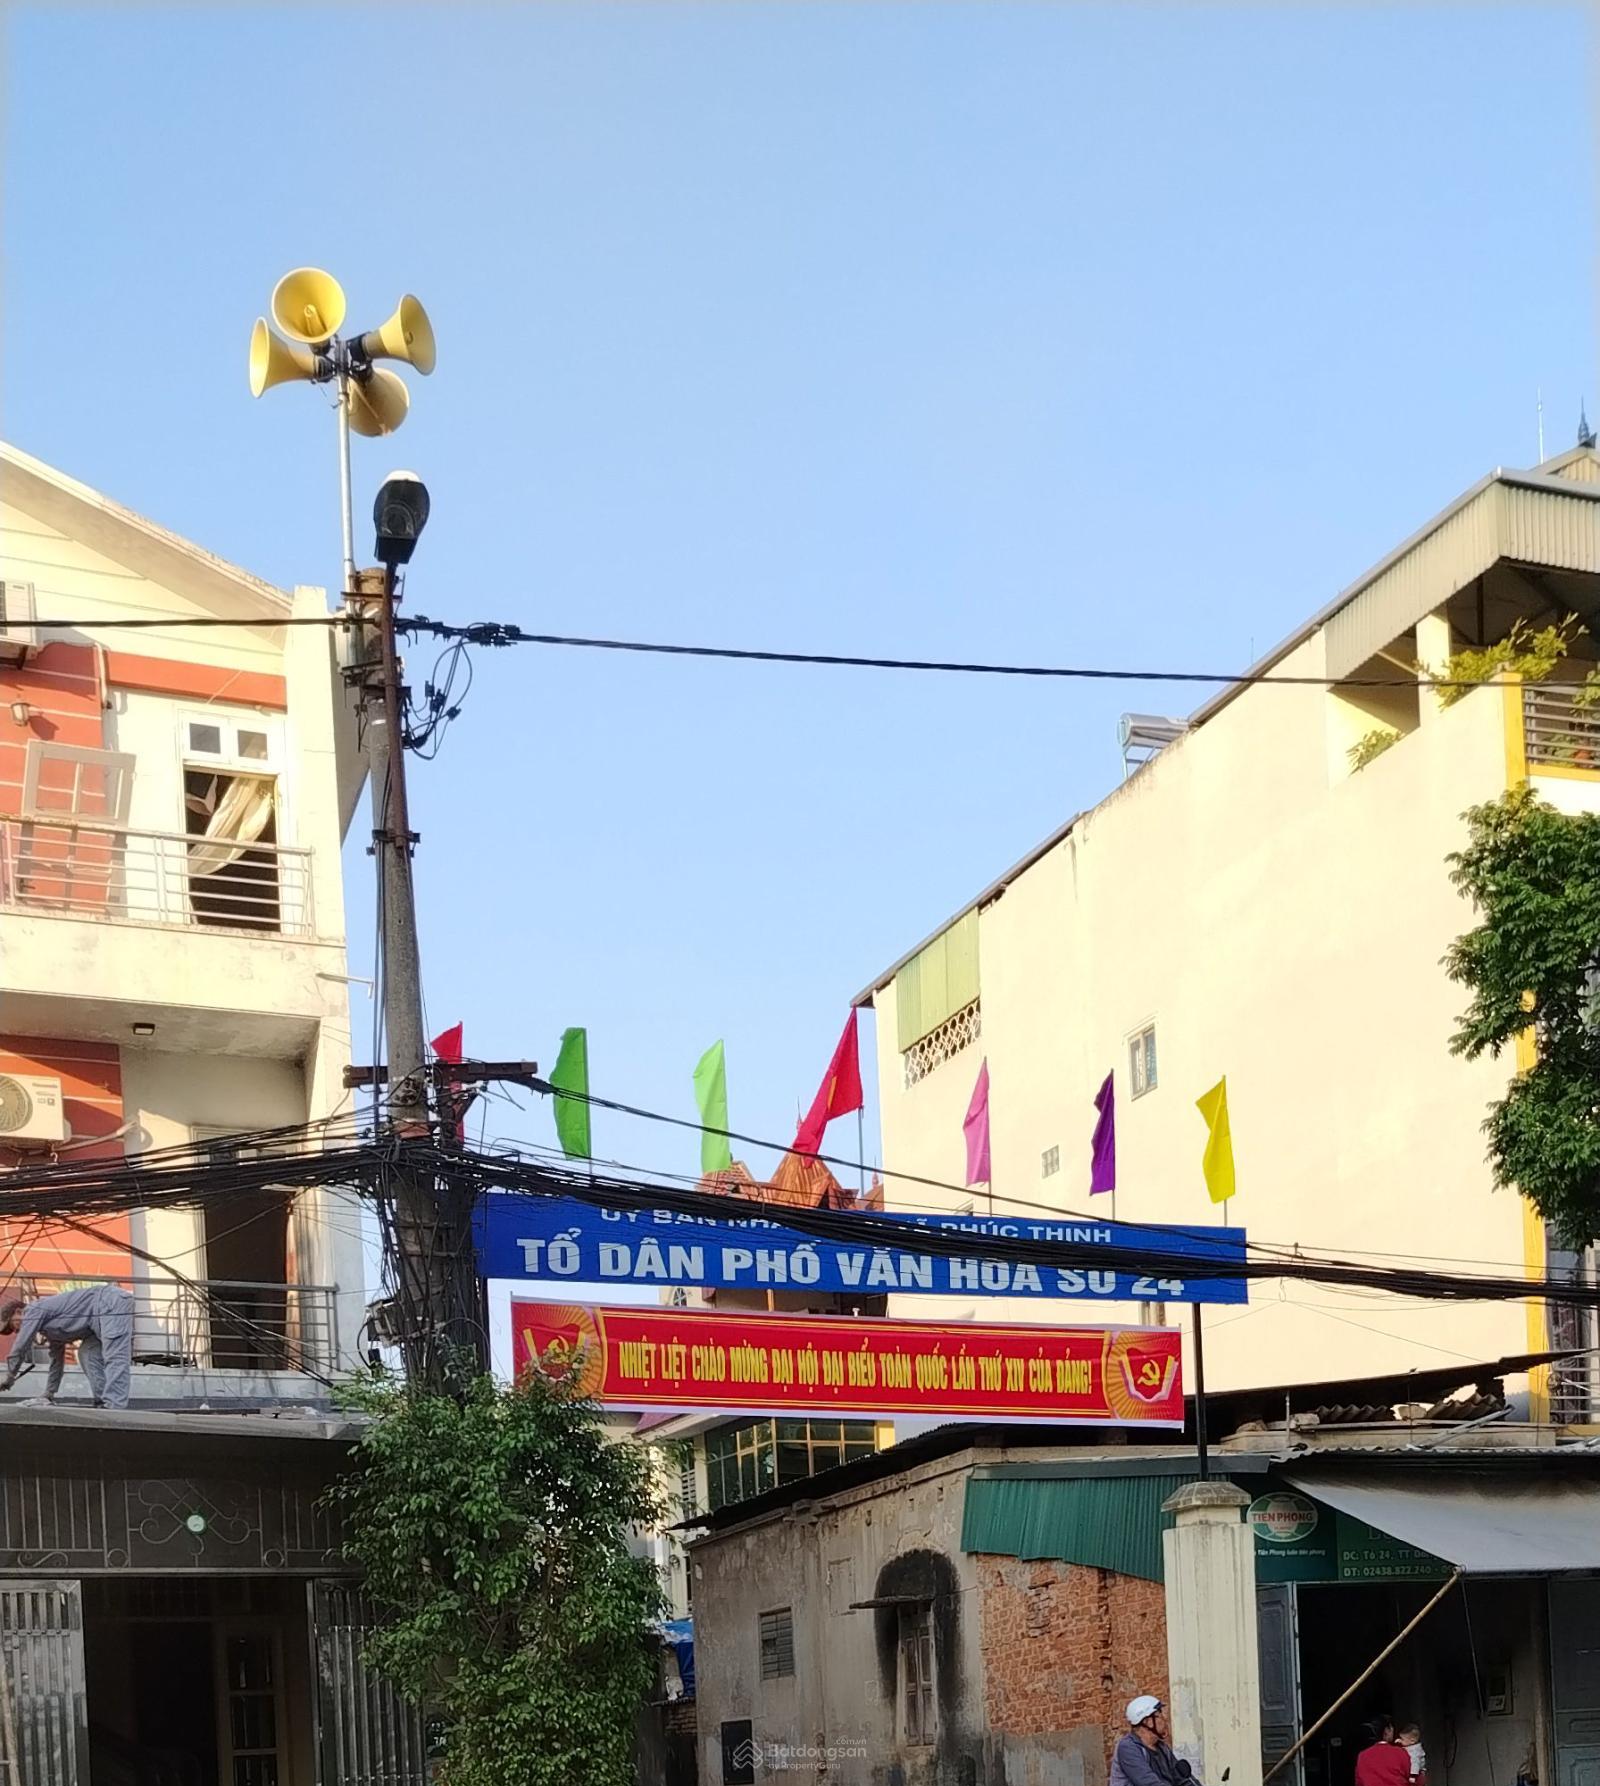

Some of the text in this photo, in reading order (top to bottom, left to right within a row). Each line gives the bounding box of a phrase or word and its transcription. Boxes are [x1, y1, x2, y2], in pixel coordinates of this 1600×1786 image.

[516, 1227, 582, 1275] TỔ
[599, 1236, 705, 1280] DÂN
[722, 1239, 821, 1284] PHỐ
[836, 1246, 933, 1289] VĂN
[618, 1334, 1092, 1394] NHIỆT LIỆT CHÀO MỪNG ĐẠI HỘI ĐẠI BIỂU TOÀN QUỐC LẦN THỨ XIV CỦA ĐẢNG!
[1277, 1512, 1313, 1522] PHONG
